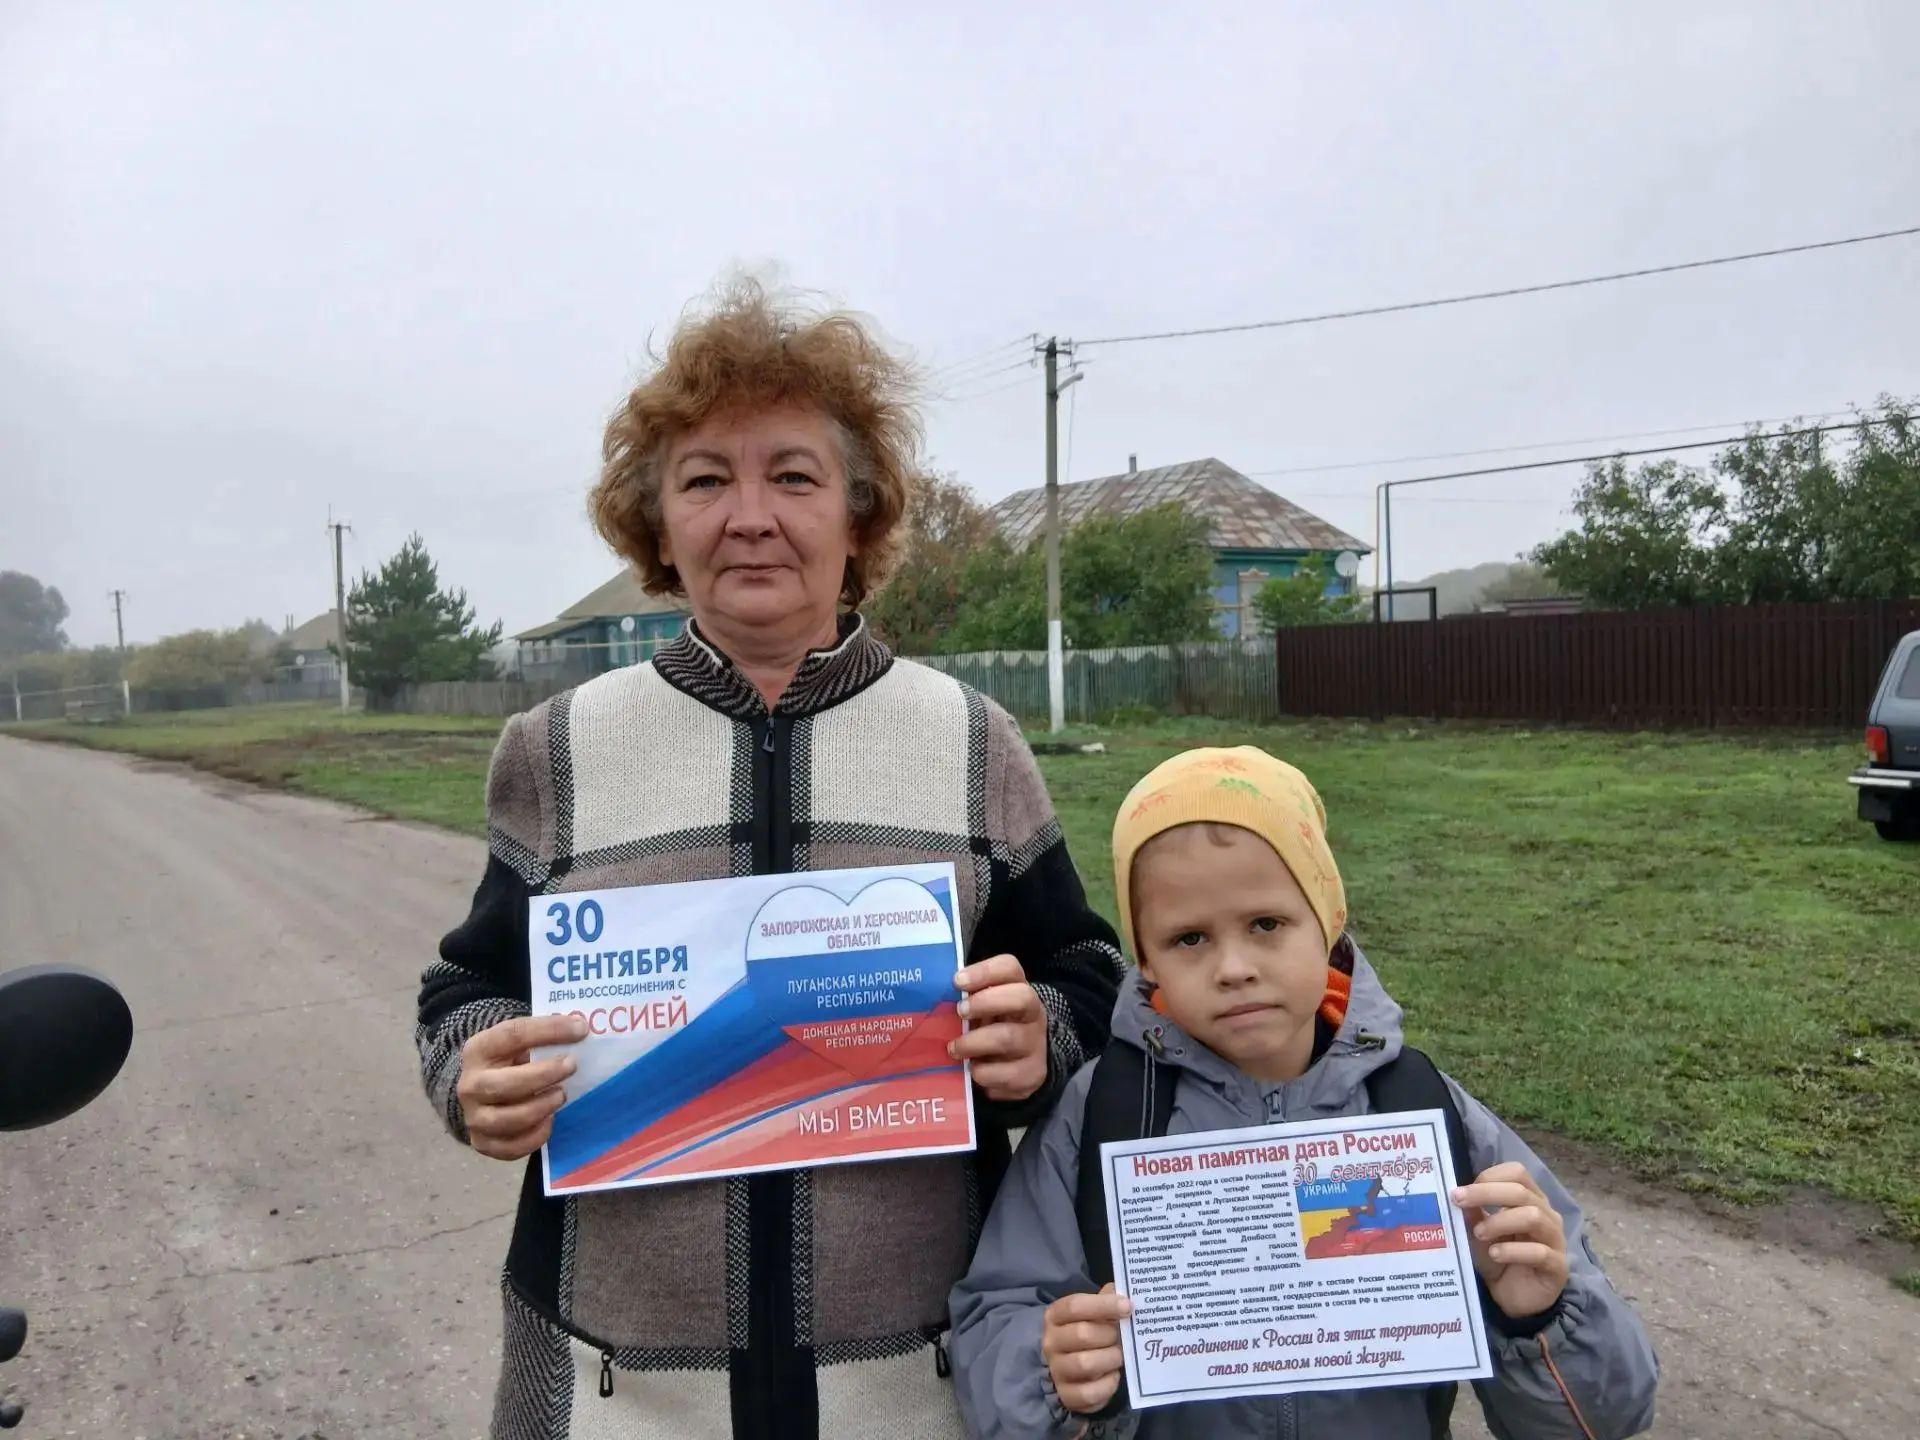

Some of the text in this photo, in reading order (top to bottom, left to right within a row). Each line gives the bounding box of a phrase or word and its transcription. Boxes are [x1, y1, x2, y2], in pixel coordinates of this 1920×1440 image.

[546, 898, 604, 946] 30
[761, 909, 938, 937] ЗАПОРОЖСКАЯ И ХЕРСОНСКАЯ
[827, 931, 881, 949] ОБЛАСТИ
[547, 944, 688, 984] СЕНТЯБРЯ
[549, 978, 686, 1003] ДЕНЬ ВОССОЕДИНЕНИЯ С
[787, 968, 922, 994] ЛУГАНСКАЯ НАРОДНАЯ
[817, 989, 895, 1009] РЕСПУБЛИКА
[551, 995, 688, 1036] ССИЕЙ
[803, 1017, 913, 1040] ДОНЕЦКАЯ НАРОДНАЯ
[825, 1034, 892, 1049] РЕСПУБЛИКА
[798, 1098, 947, 1136] МЫ ВМЕСТЕ
[1133, 1133, 1417, 1177] Новая памятная дата России
[1292, 1152, 1434, 1187] 30 сентября
[1142, 1183, 1175, 1192] сентября
[1245, 1170, 1287, 1180] Российской
[1303, 1182, 1348, 1198] УКРАИНА
[1121, 1195, 1163, 1205] Федерации
[1175, 1189, 1212, 1199] вернулись
[1224, 1185, 1250, 1193] четыре
[1123, 1206, 1152, 1216] региона
[1166, 1200, 1202, 1211] Донецкая
[1213, 1195, 1250, 1205] Луганская
[1253, 1191, 1290, 1200] народные
[1232, 1203, 1274, 1212] Херсонская
[1125, 1224, 1172, 1234] Запорожская
[1207, 1217, 1244, 1226] Договоры
[1154, 1230, 1197, 1241] территорий
[1202, 1228, 1222, 1236] были
[1226, 1224, 1268, 1234] подписаны
[1404, 1228, 1445, 1243] РОССИЯ
[1241, 1233, 1276, 1243] Донбасса
[1128, 1254, 1172, 1264] Новороссии
[1183, 1268, 1216, 1279] сентября
[1132, 1287, 1151, 1295] День
[1144, 1295, 1178, 1303] Согласно
[1181, 1288, 1236, 1299] подписанному
[1240, 1286, 1265, 1294] закону
[1269, 1283, 1285, 1291] ДНР
[1326, 1278, 1354, 1286] составе
[1358, 1275, 1385, 1283] России
[1431, 1269, 1455, 1277] статус
[1135, 1305, 1174, 1316] республик
[1194, 1309, 1237, 1319] Херсонская
[1240, 1306, 1269, 1315] области
[1332, 1299, 1356, 1307] состав
[1381, 1294, 1414, 1302] качестве
[1417, 1290, 1459, 1300] отдельных
[1137, 1326, 1174, 1336] субъектов
[1175, 1321, 1219, 1331] Федерации
[1144, 1318, 1462, 1362] Присоединение к России для этих территорий
[1207, 1346, 1405, 1377] стало началом новой жизни.
